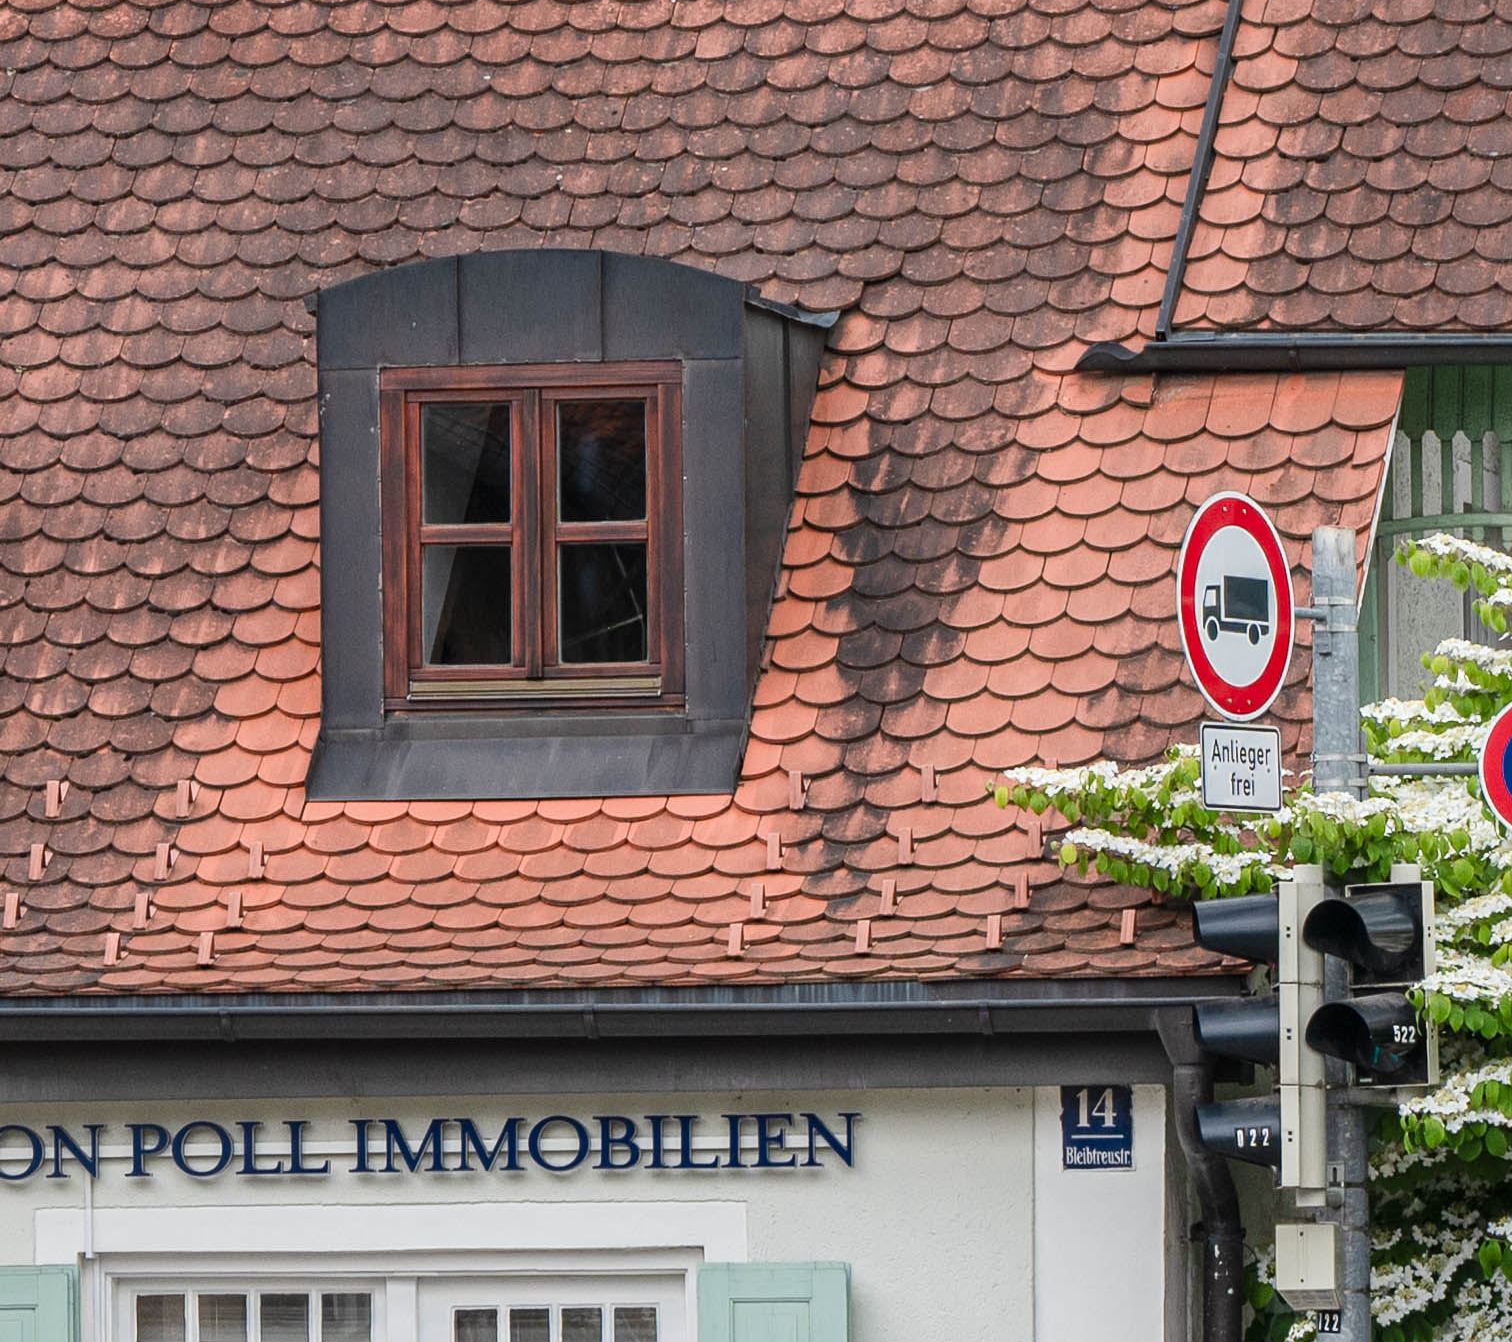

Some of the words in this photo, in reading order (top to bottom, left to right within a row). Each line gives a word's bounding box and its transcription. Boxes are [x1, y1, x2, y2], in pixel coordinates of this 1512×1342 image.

[1211, 738, 1271, 771] Anlieger
[1230, 772, 1255, 796] frei
[1392, 1025, 1416, 1043] 522
[1076, 1088, 1117, 1127] 14
[125, 1119, 332, 1178] POLL
[348, 1112, 863, 1174] IMMOBILIEN
[1066, 1146, 1131, 1165] Bleibtreustr.
